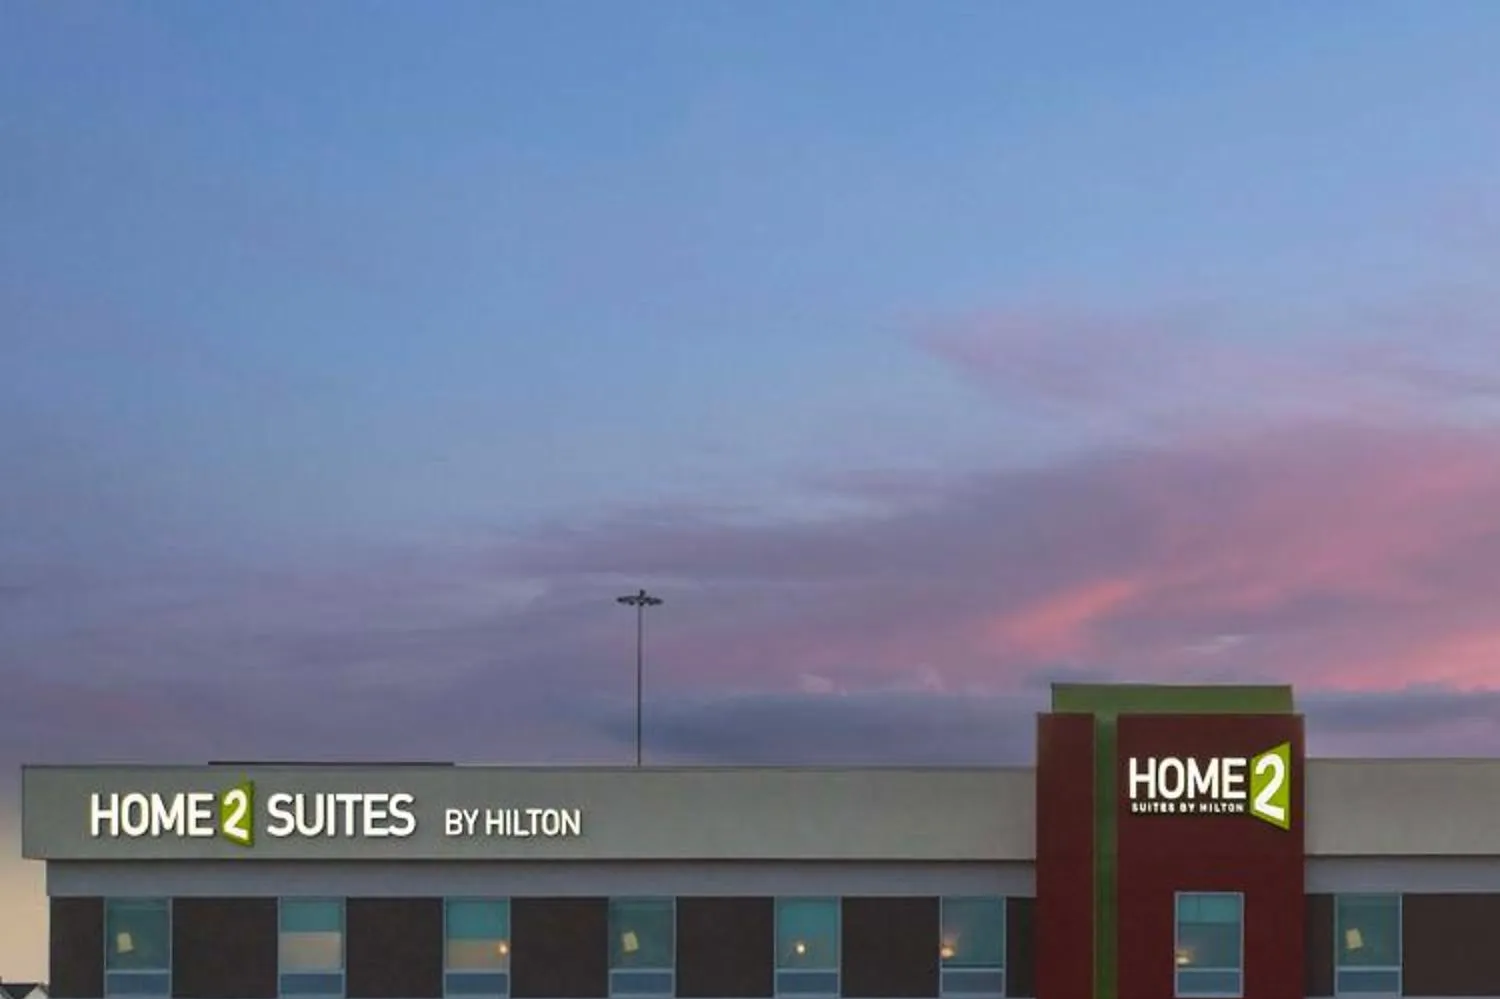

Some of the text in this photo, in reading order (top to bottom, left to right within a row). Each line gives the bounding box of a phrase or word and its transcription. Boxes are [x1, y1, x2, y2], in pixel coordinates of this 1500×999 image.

[1128, 756, 1247, 800] HOME
[90, 788, 582, 841] HOME 2 SUITES BY HILTON
[1131, 802, 1245, 813] SUITES BY HILTON
